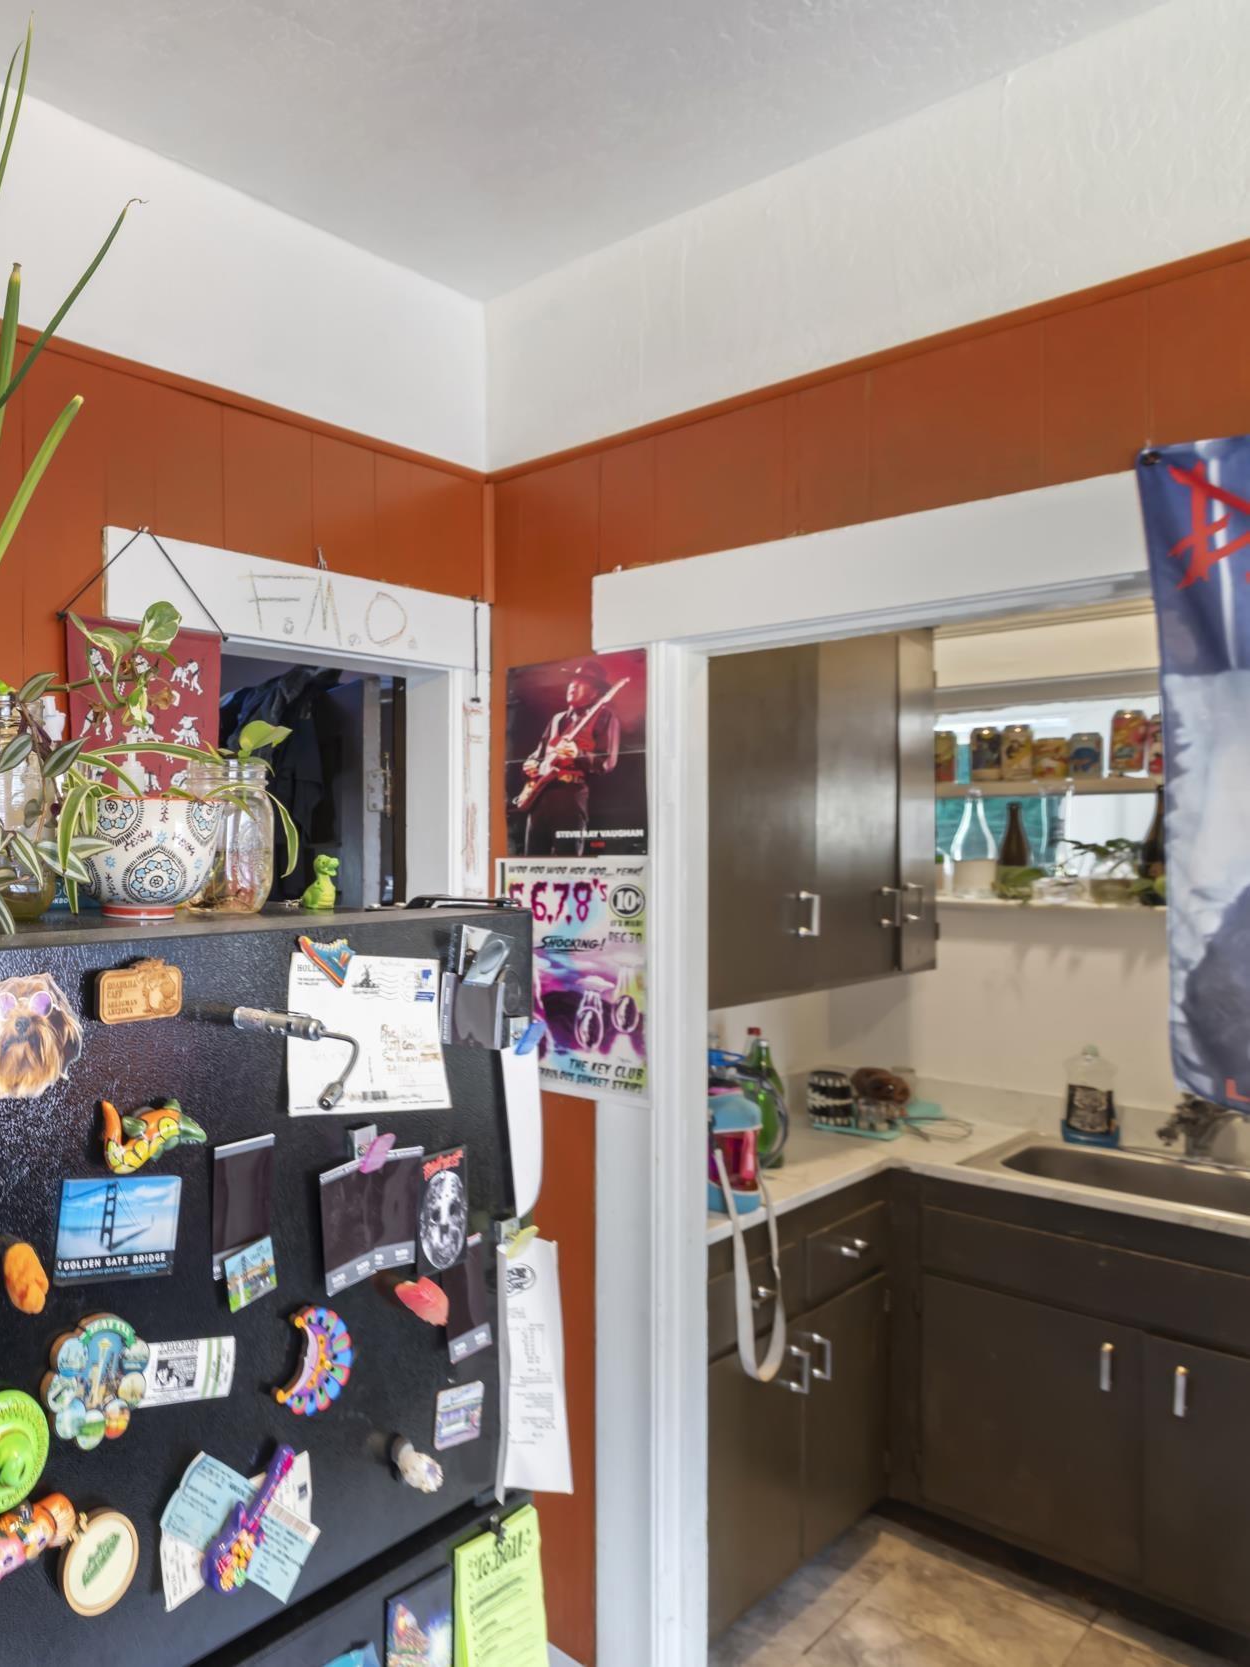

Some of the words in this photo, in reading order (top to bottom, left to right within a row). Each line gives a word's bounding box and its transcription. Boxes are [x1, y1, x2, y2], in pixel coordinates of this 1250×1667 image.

[555, 830, 581, 839] STEVIE
[582, 829, 599, 838] RAY
[599, 828, 644, 838] VAUGHAN
[535, 935, 607, 951] SHOCKING!
[569, 1058, 588, 1072] THE
[591, 1061, 612, 1075] KEY
[614, 1065, 644, 1080] CLUB
[63, 1258, 102, 1271] GOLDEN
[105, 1255, 129, 1267] GATE
[132, 1252, 167, 1265] BRIDGE
